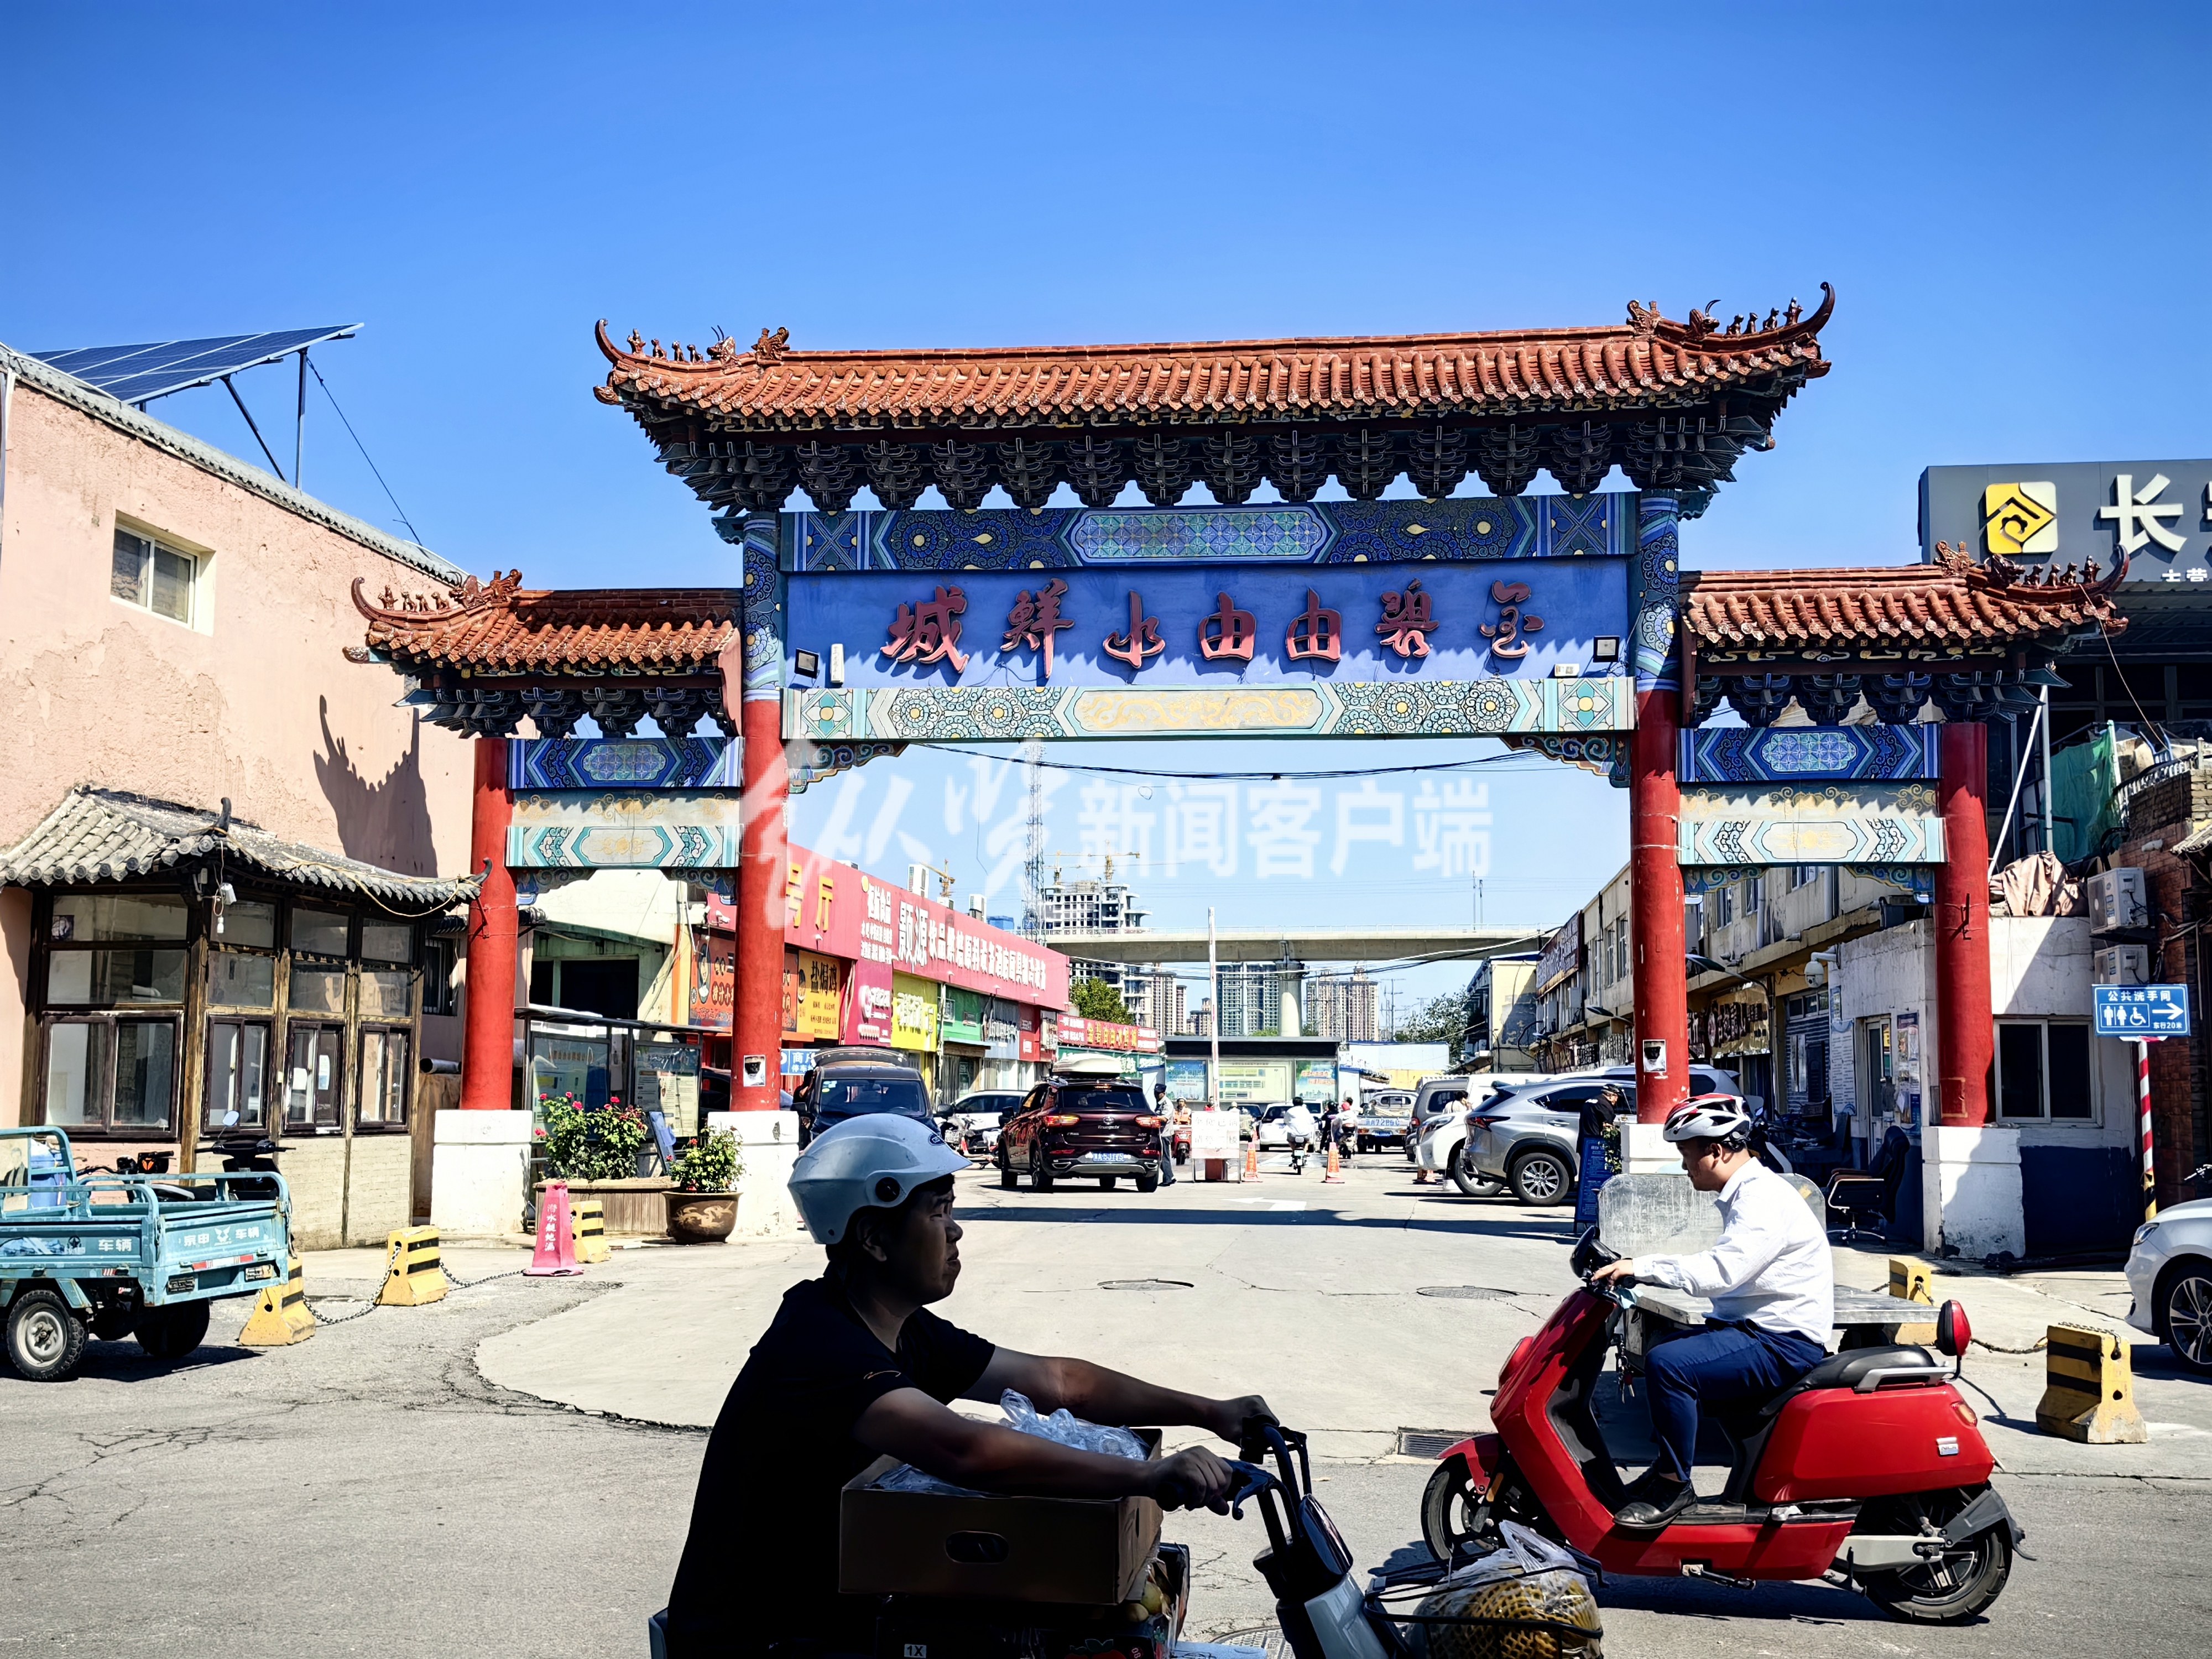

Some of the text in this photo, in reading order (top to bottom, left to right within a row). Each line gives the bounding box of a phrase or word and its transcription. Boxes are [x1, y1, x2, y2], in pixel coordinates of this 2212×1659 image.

[2100, 474, 2212, 553] 长
[2108, 990, 2171, 1001] 公共洗手间
[2153, 1021, 2182, 1030] 东行20米
[236, 1226, 259, 1239] 车辆
[98, 1239, 132, 1252] 车辆
[906, 1645, 924, 1657] 1X
